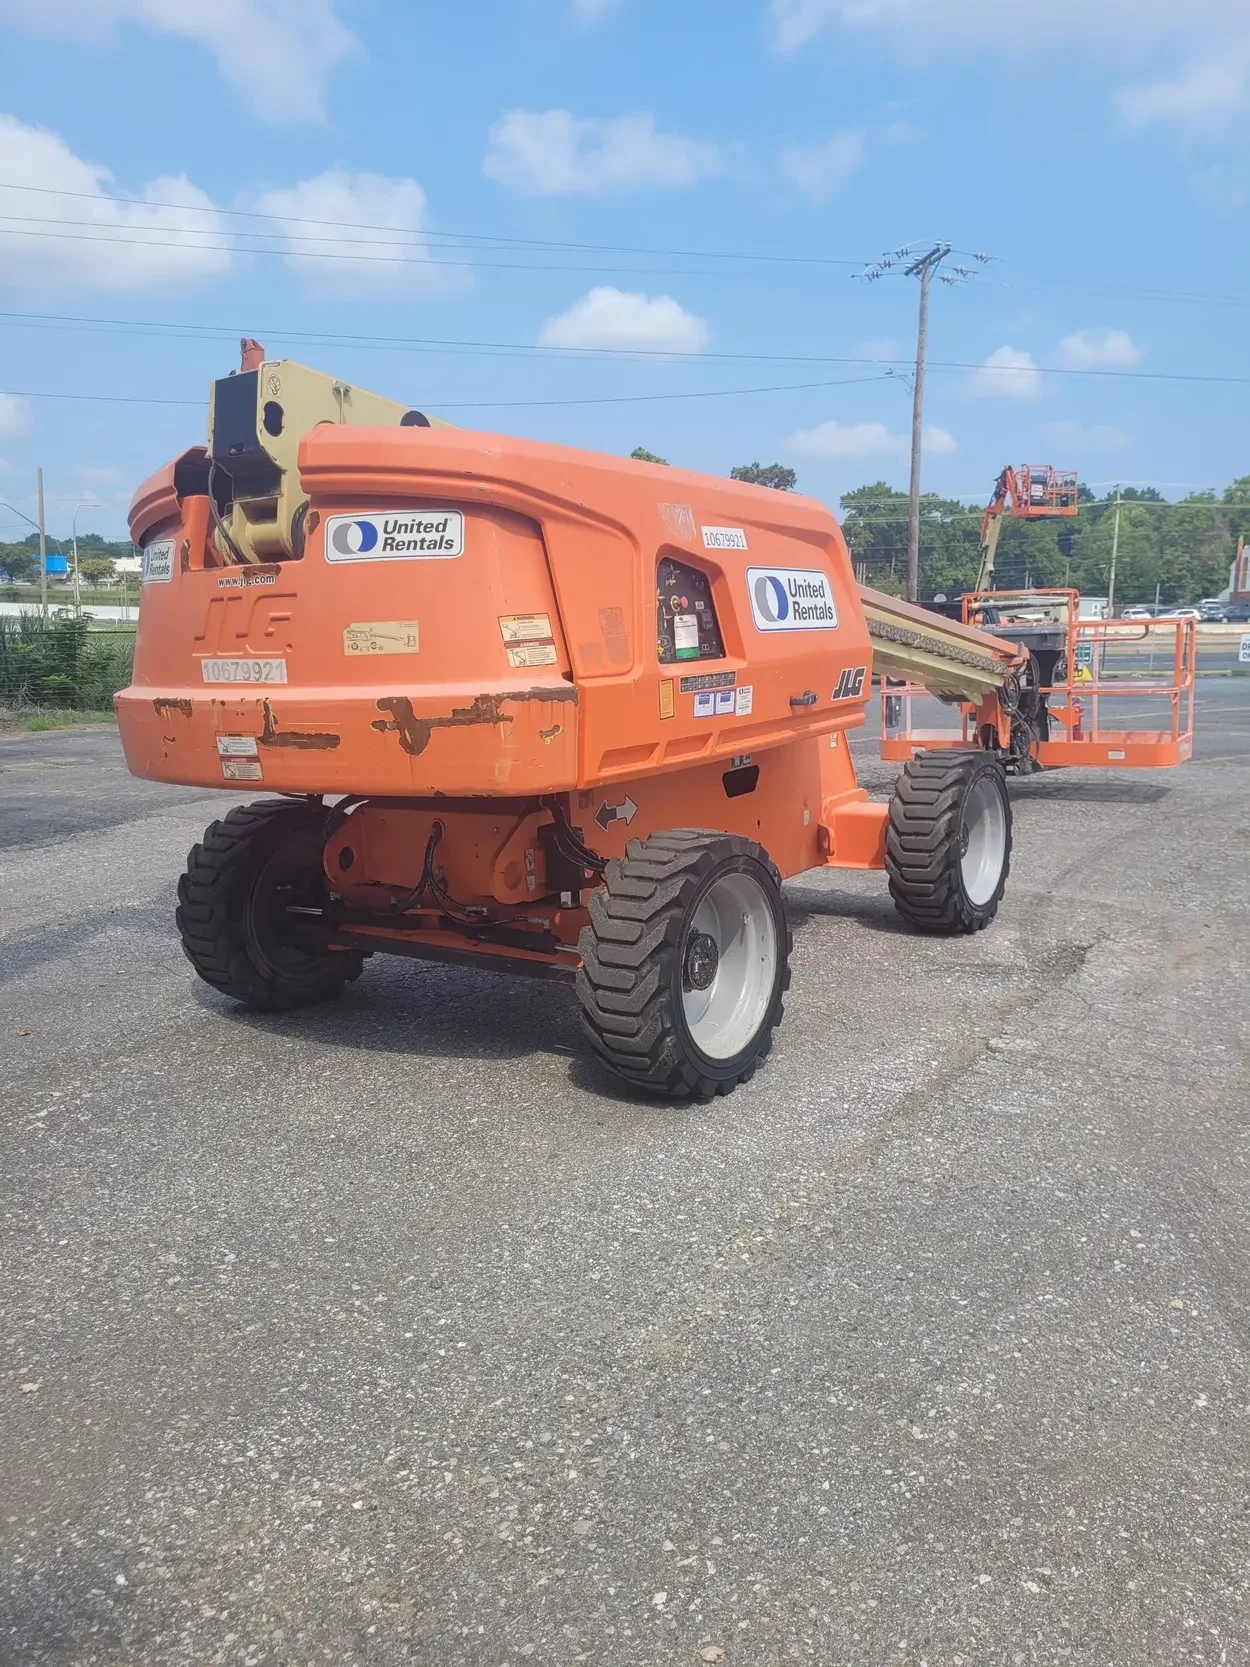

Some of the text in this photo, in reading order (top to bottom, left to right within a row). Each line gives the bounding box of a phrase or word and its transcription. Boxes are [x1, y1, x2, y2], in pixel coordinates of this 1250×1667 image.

[382, 518, 449, 535] United
[382, 535, 455, 552] Rentals
[704, 532, 746, 548] 10679921
[788, 578, 826, 599] United
[792, 601, 834, 621] Rentals
[204, 661, 284, 681] 10679921
[831, 666, 867, 700] JLG
